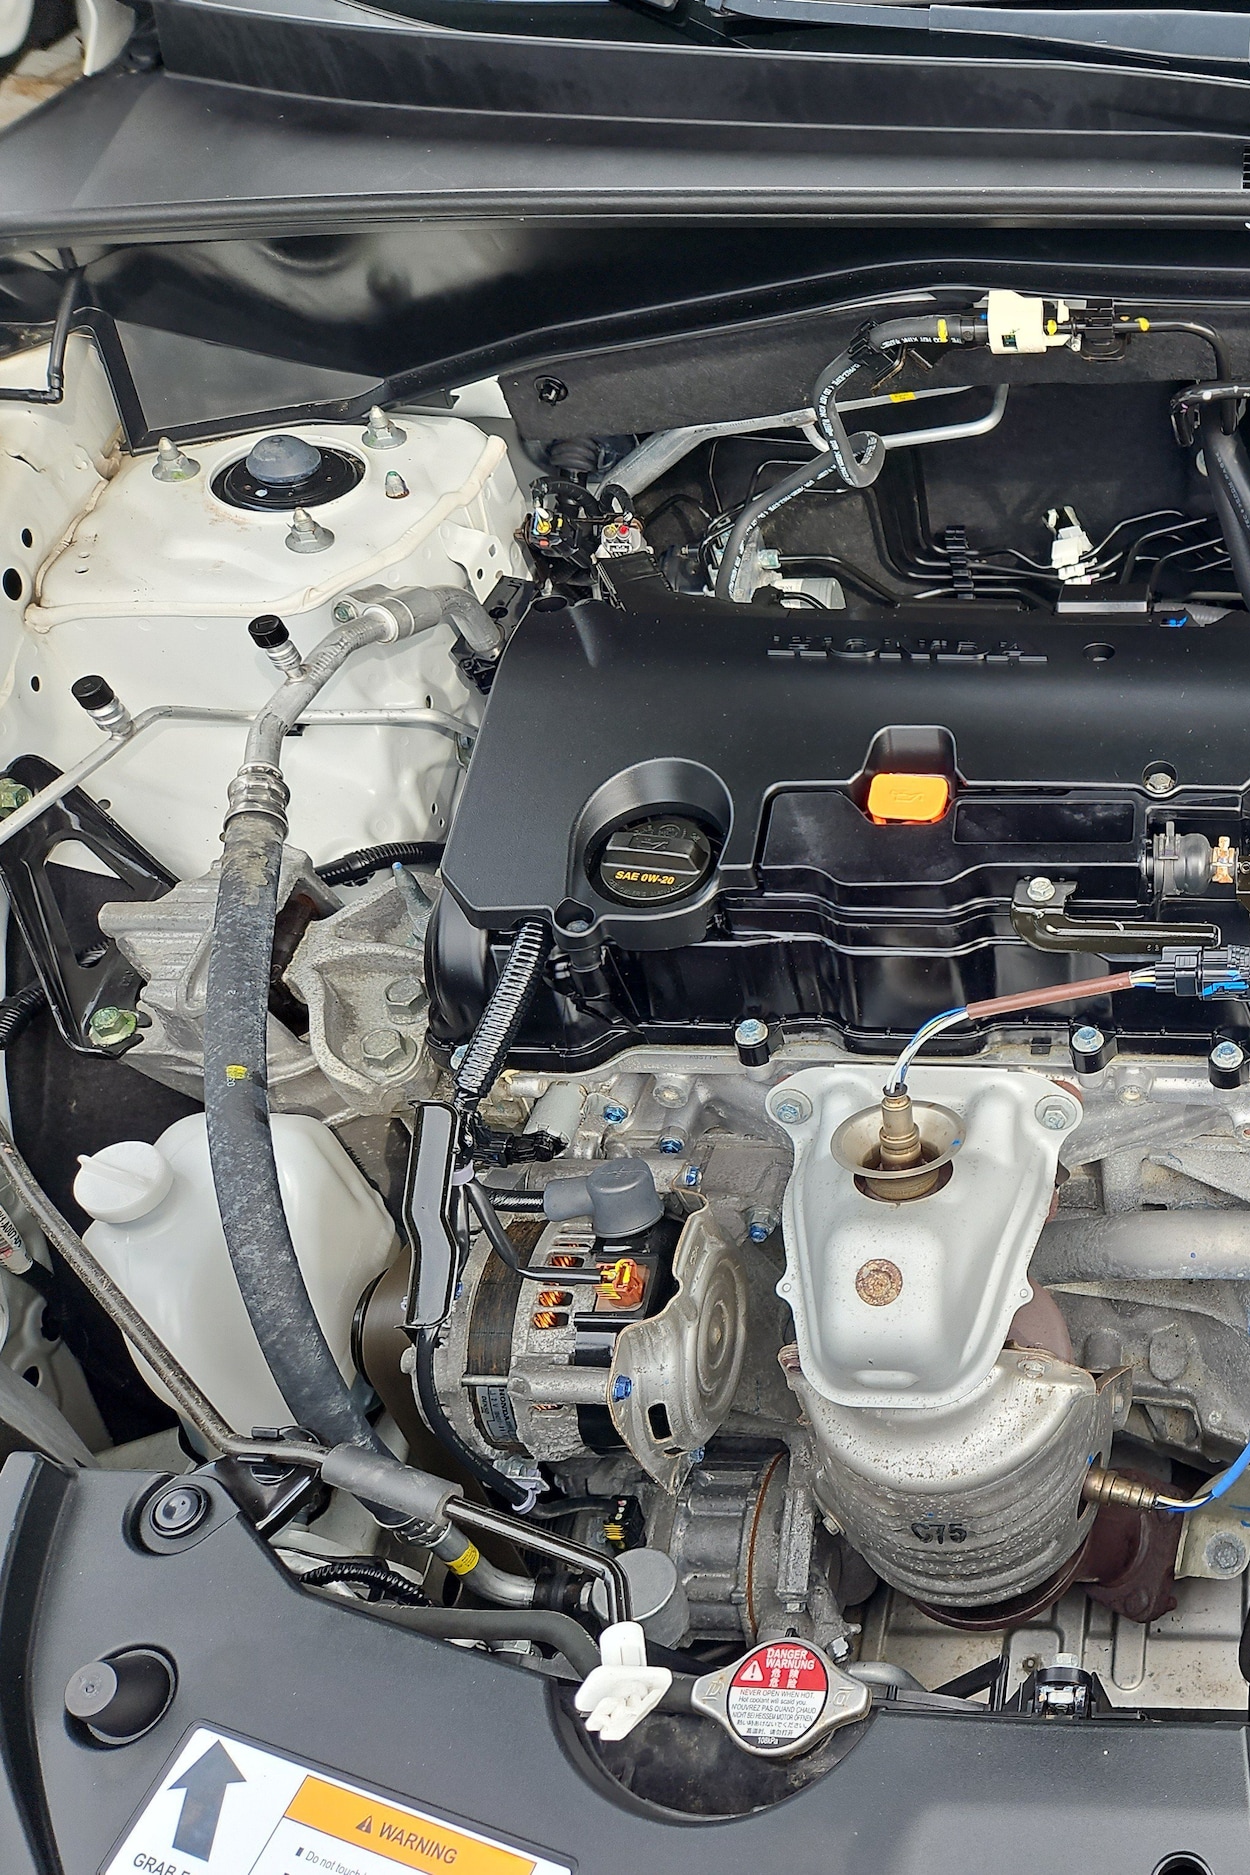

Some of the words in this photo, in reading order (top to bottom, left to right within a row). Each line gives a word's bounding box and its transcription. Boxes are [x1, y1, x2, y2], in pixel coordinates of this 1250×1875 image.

[615, 870, 641, 881] SAE
[641, 873, 675, 886] 0W-20
[766, 1647, 808, 1660] DANGER
[765, 1658, 815, 1670] WARNUNG
[776, 1713, 794, 1721] MOTOR
[379, 1822, 458, 1864] WARNING
[133, 1853, 177, 1875] GRAB
[305, 1850, 319, 1864] Do
[319, 1858, 337, 1871] not
